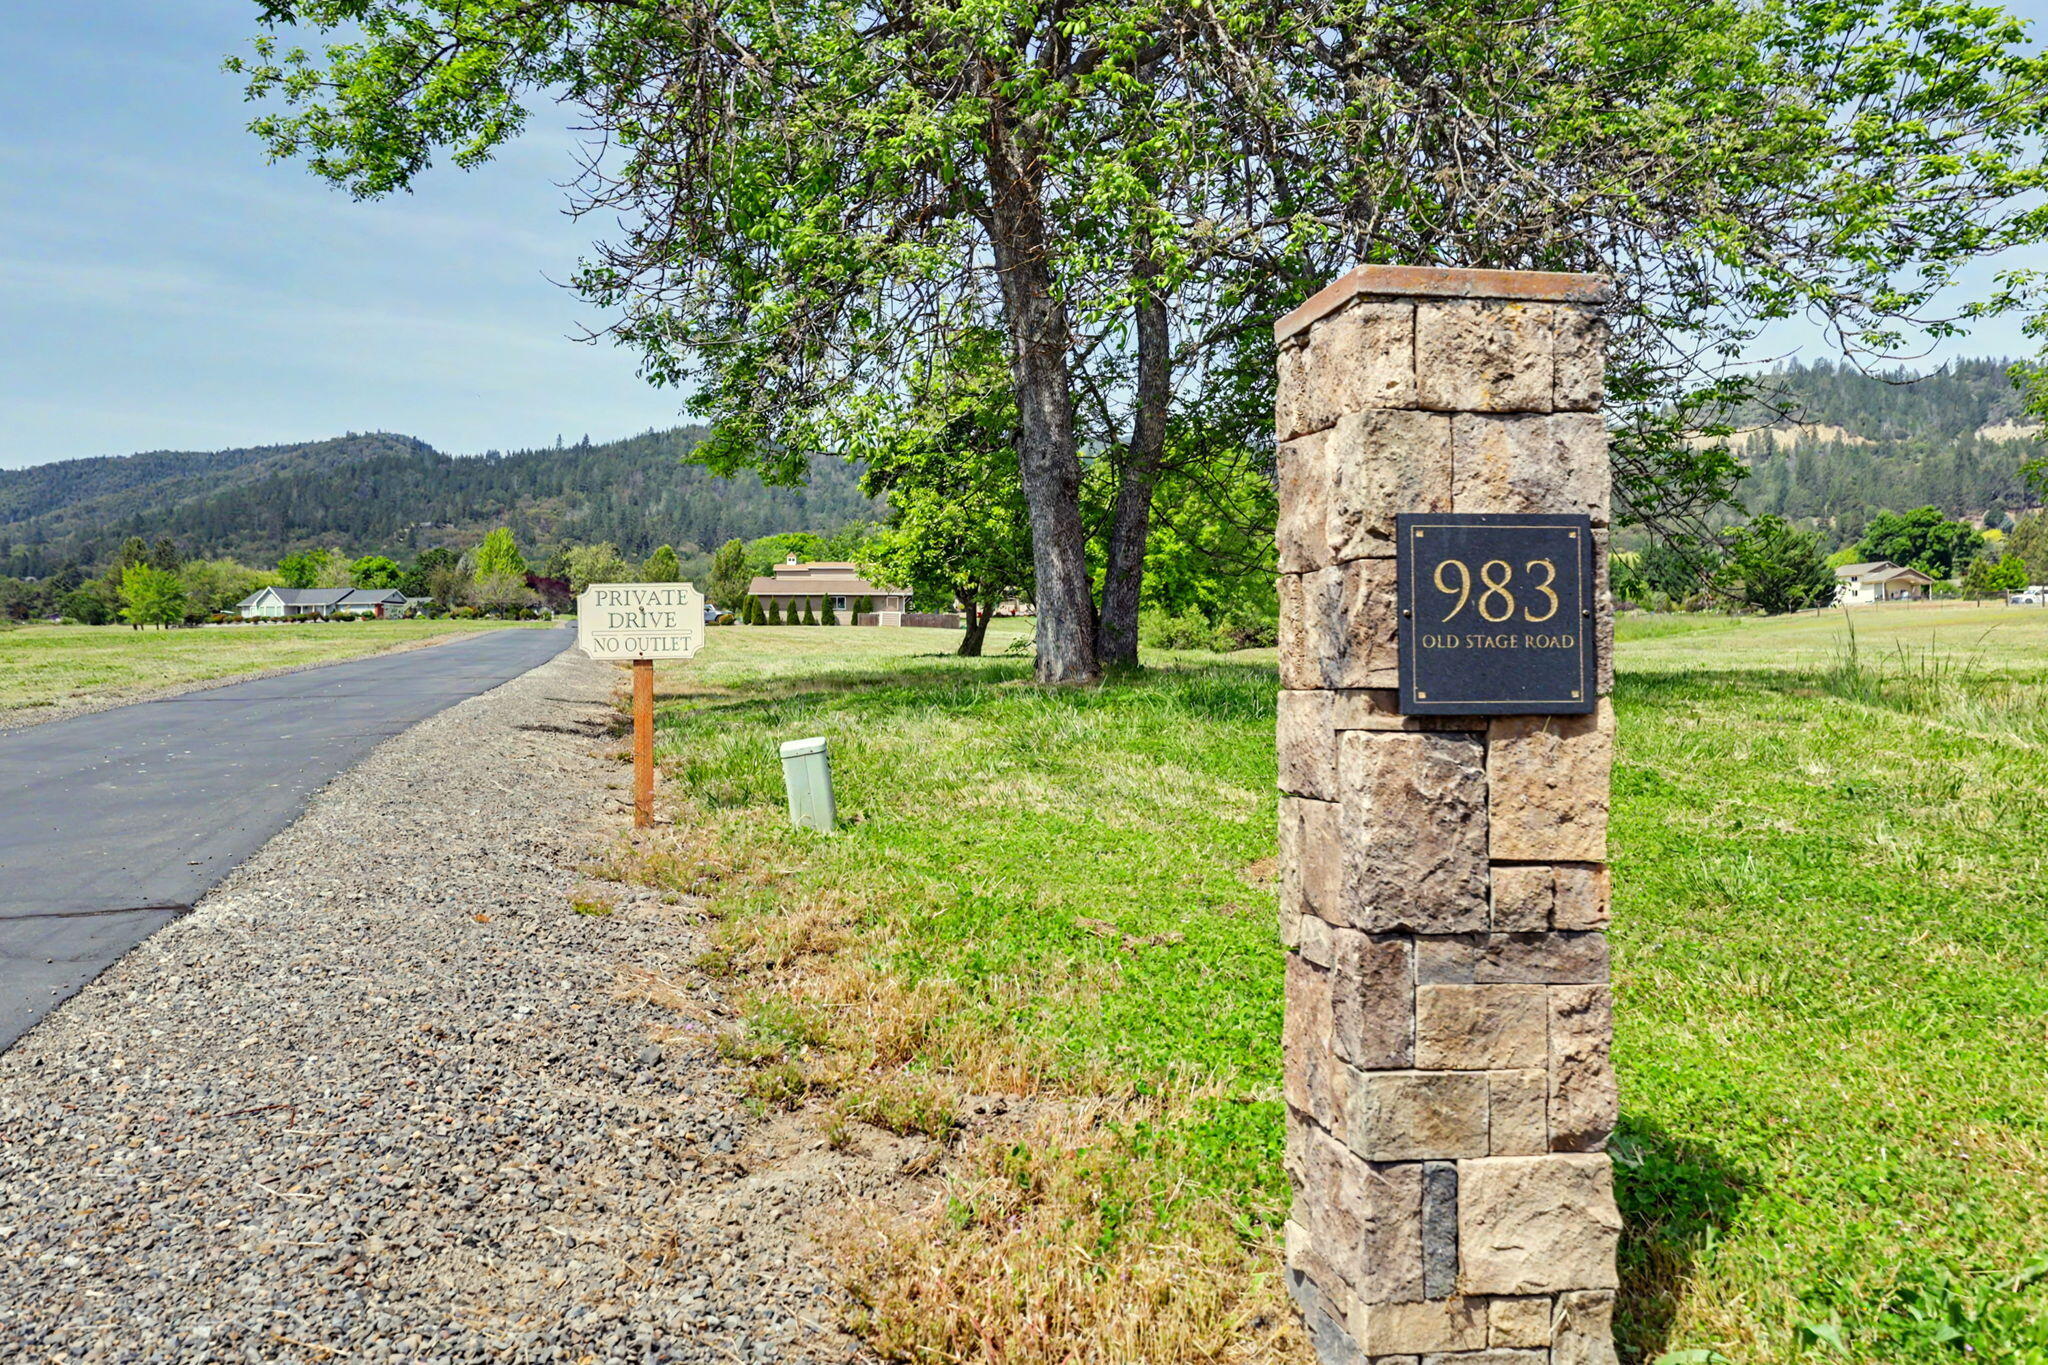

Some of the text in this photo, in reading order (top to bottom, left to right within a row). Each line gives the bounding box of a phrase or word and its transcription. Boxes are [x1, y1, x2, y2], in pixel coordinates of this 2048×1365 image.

[595, 589, 688, 606] PRIVATE
[1433, 559, 1559, 622] 983
[608, 611, 677, 629] DRIVE
[593, 636, 691, 652] NO OUTLET
[1422, 634, 1575, 649] OLD STAGE ROAD
